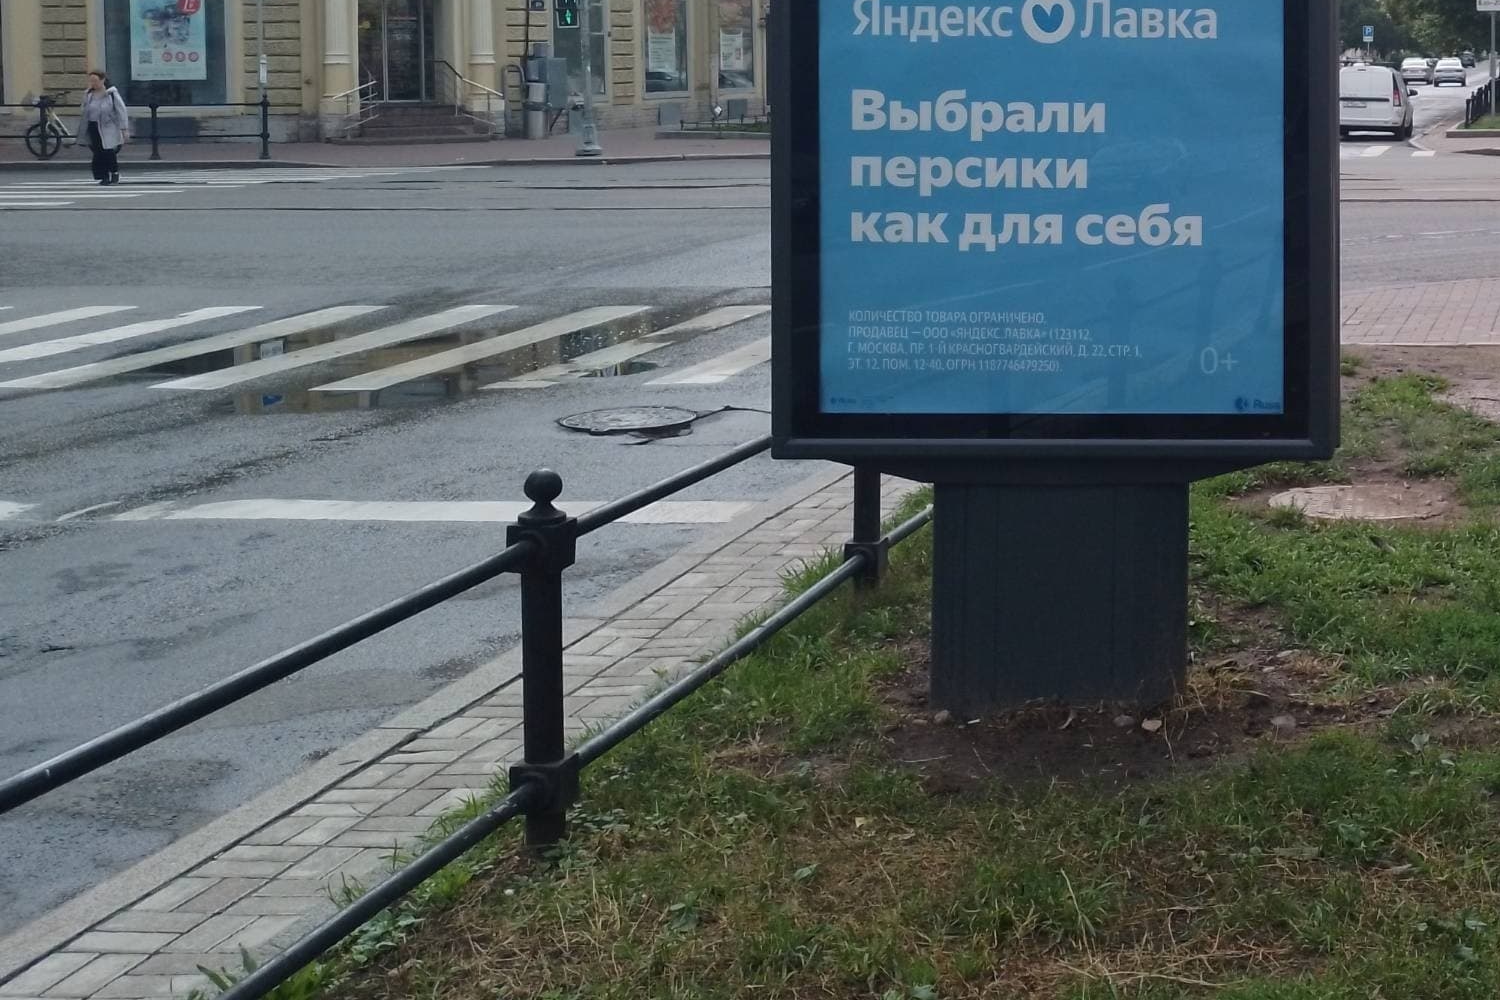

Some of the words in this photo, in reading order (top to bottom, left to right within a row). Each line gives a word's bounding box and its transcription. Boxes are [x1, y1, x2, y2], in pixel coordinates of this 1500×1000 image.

[851, 88, 1106, 141] Выбрали
[850, 155, 1088, 197] персики
[850, 210, 949, 243] как
[958, 213, 1063, 252] для
[1075, 203, 1203, 247] себя
[848, 310, 922, 322] КОЛИЧЕСТВО
[926, 311, 967, 323] ТОВАРА
[848, 326, 908, 340] ПРОДАВЕЦ
[923, 327, 949, 338] ООО
[1201, 346, 1240, 375] 0+
